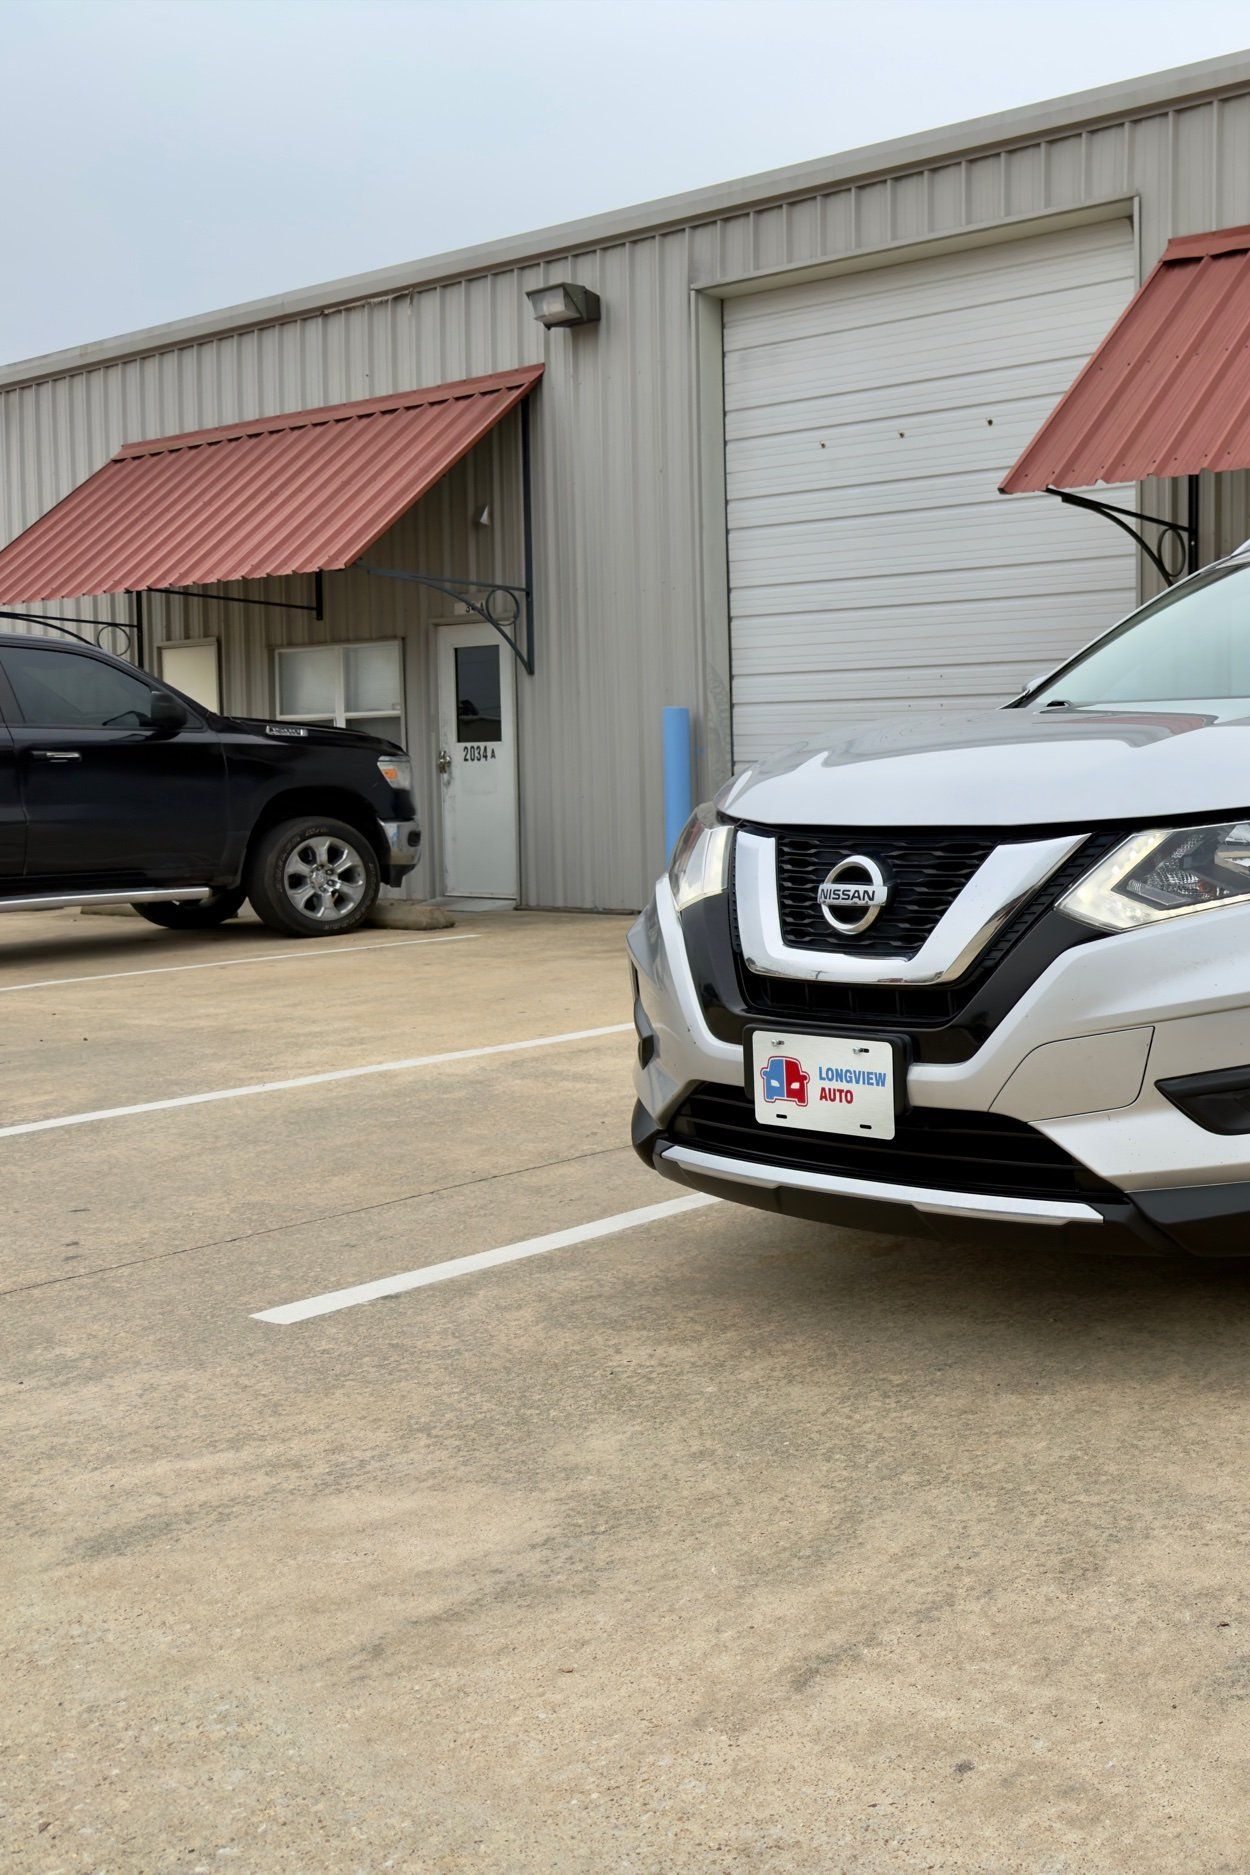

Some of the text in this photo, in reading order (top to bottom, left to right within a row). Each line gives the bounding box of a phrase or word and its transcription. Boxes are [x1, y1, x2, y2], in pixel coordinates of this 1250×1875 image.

[463, 745, 497, 762] 2034 A
[820, 888, 876, 902] NISSAN
[818, 1066, 887, 1088] LONGVIEW
[819, 1087, 854, 1105] AUTO
